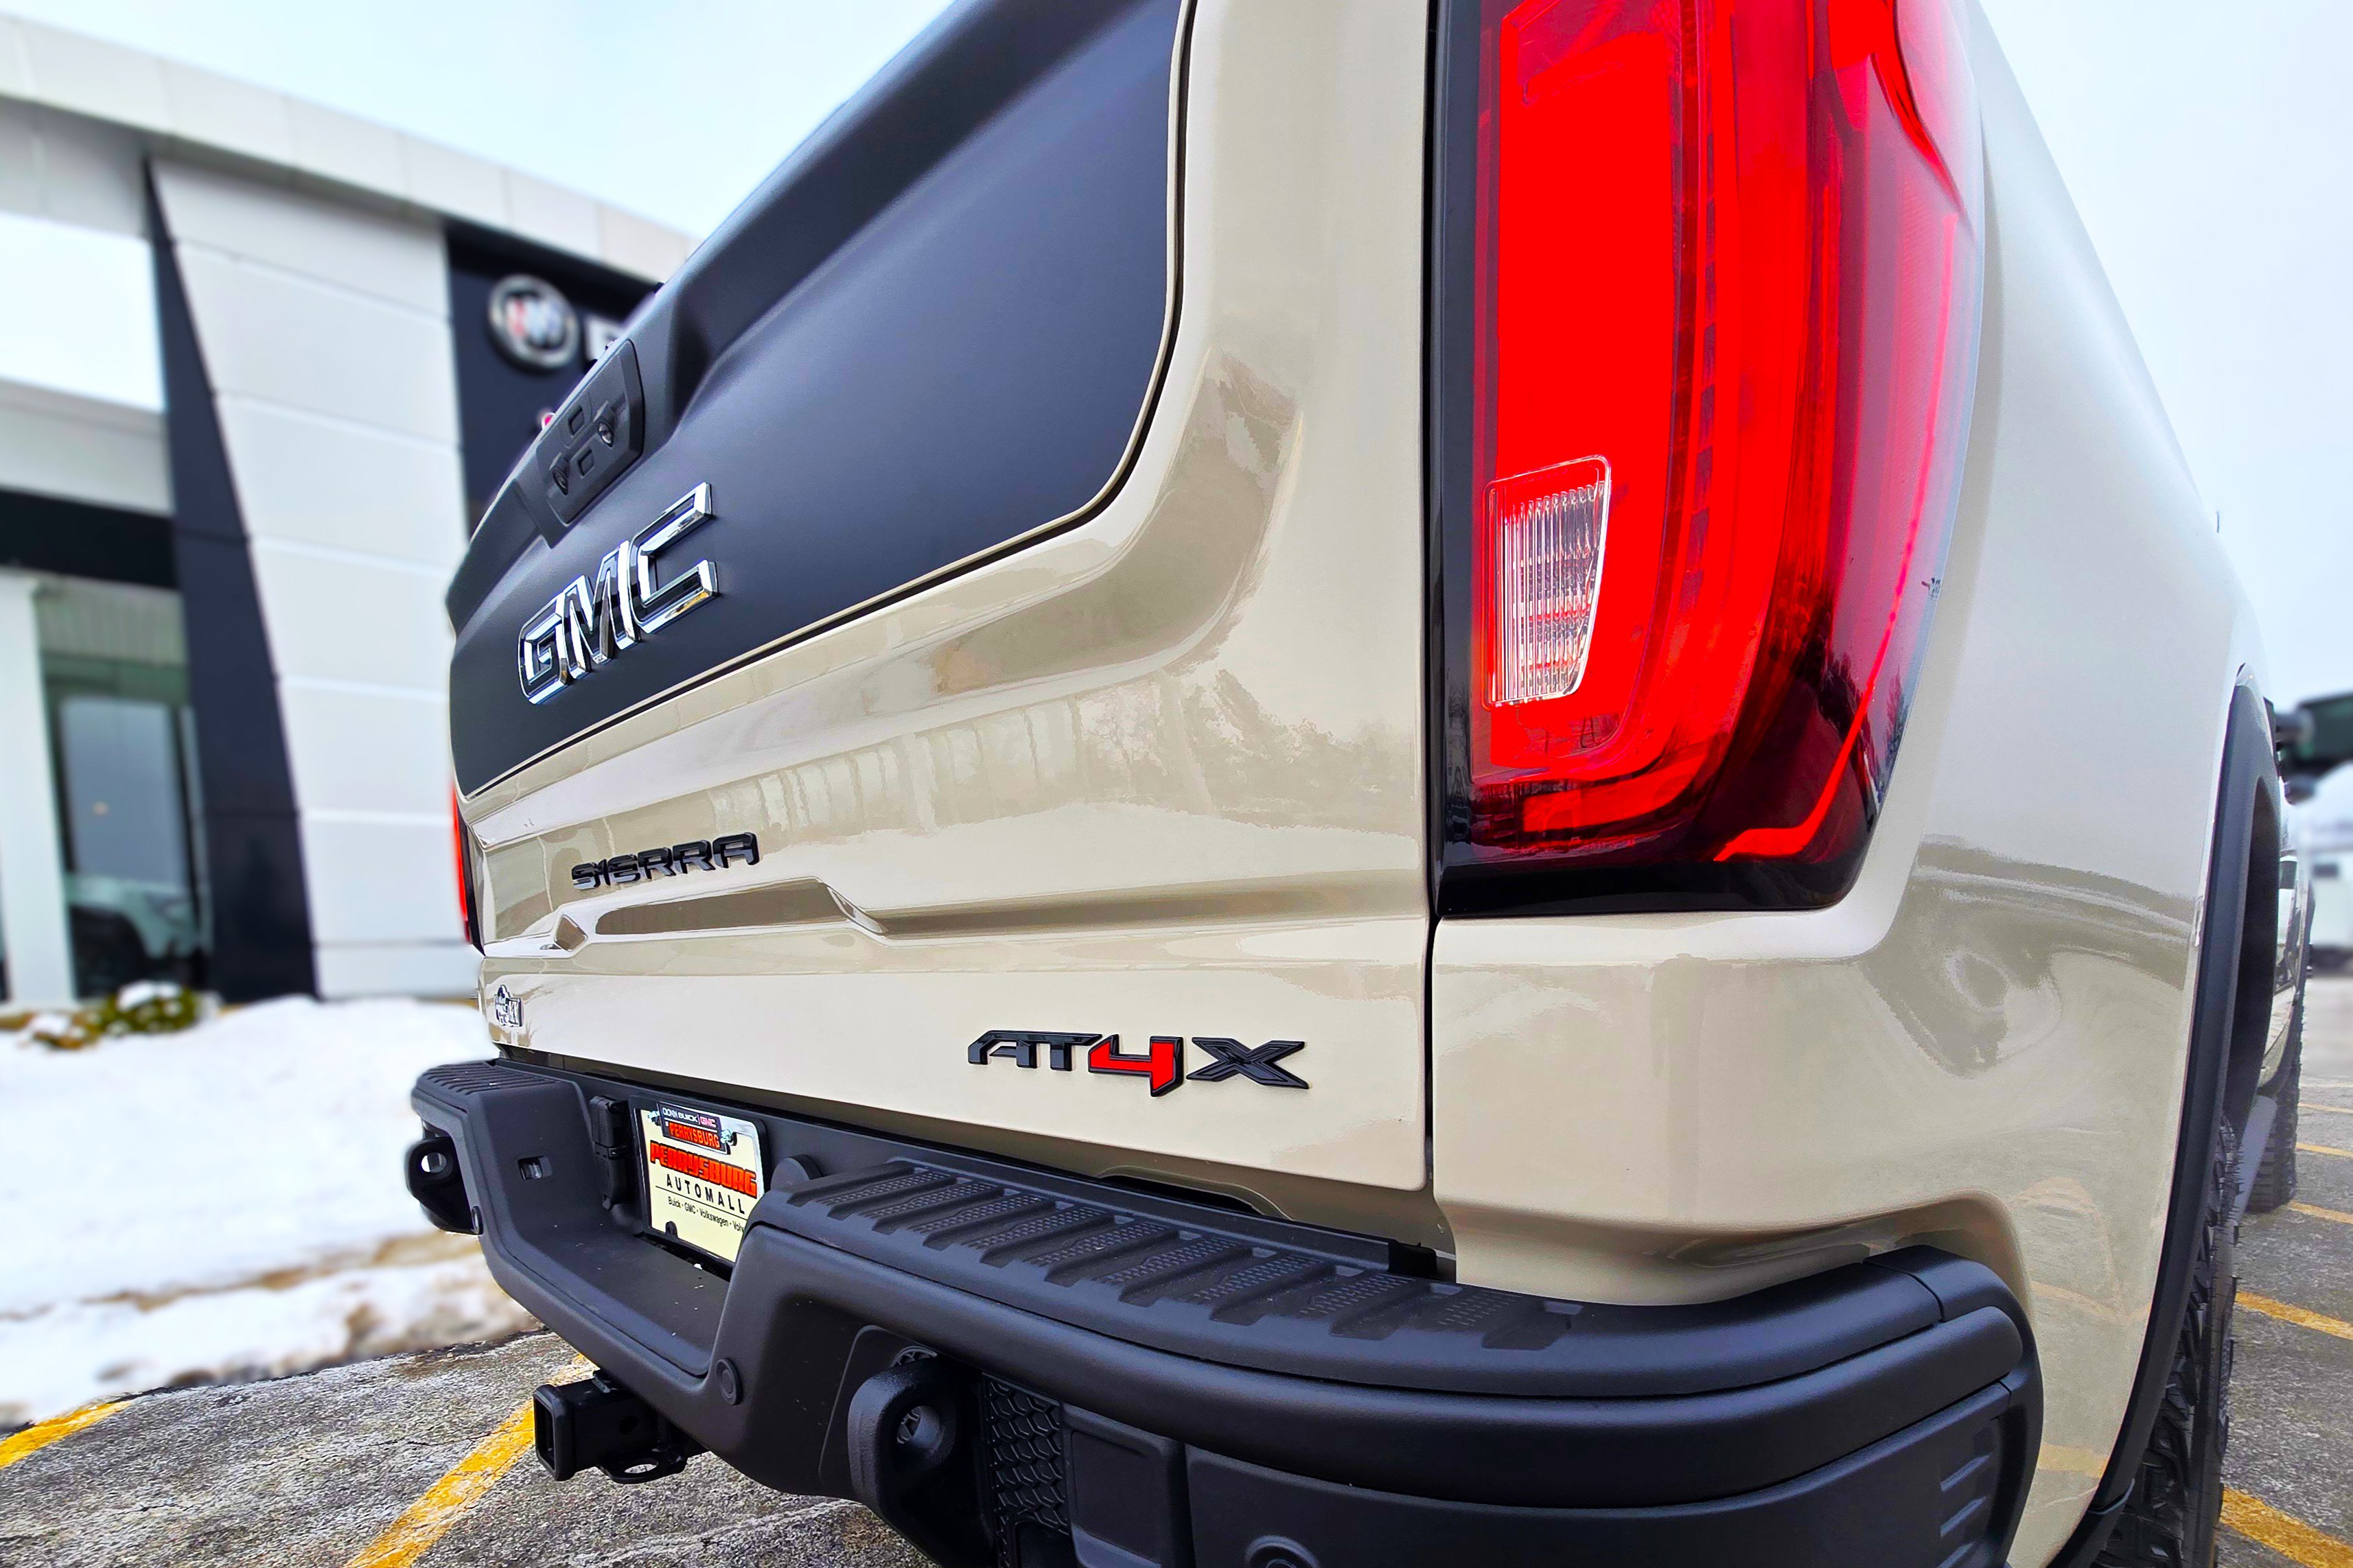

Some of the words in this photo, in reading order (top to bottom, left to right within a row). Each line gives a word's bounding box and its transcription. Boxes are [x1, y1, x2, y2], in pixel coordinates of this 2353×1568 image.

[518, 482, 719, 705] GMC
[570, 832, 761, 891] SIERRA
[967, 1029, 1310, 1097] AT4X
[669, 1122, 721, 1149] PERRYSBURG
[678, 1112, 698, 1123] BUICK
[700, 1116, 717, 1127] GMC
[649, 1139, 757, 1200] PERRYSBURG
[667, 1174, 745, 1215] AUTOMALL
[668, 1196, 681, 1208] Buick
[684, 1202, 696, 1214] GMC
[699, 1208, 729, 1227] Volkswagen
[732, 1221, 745, 1233] Volv
